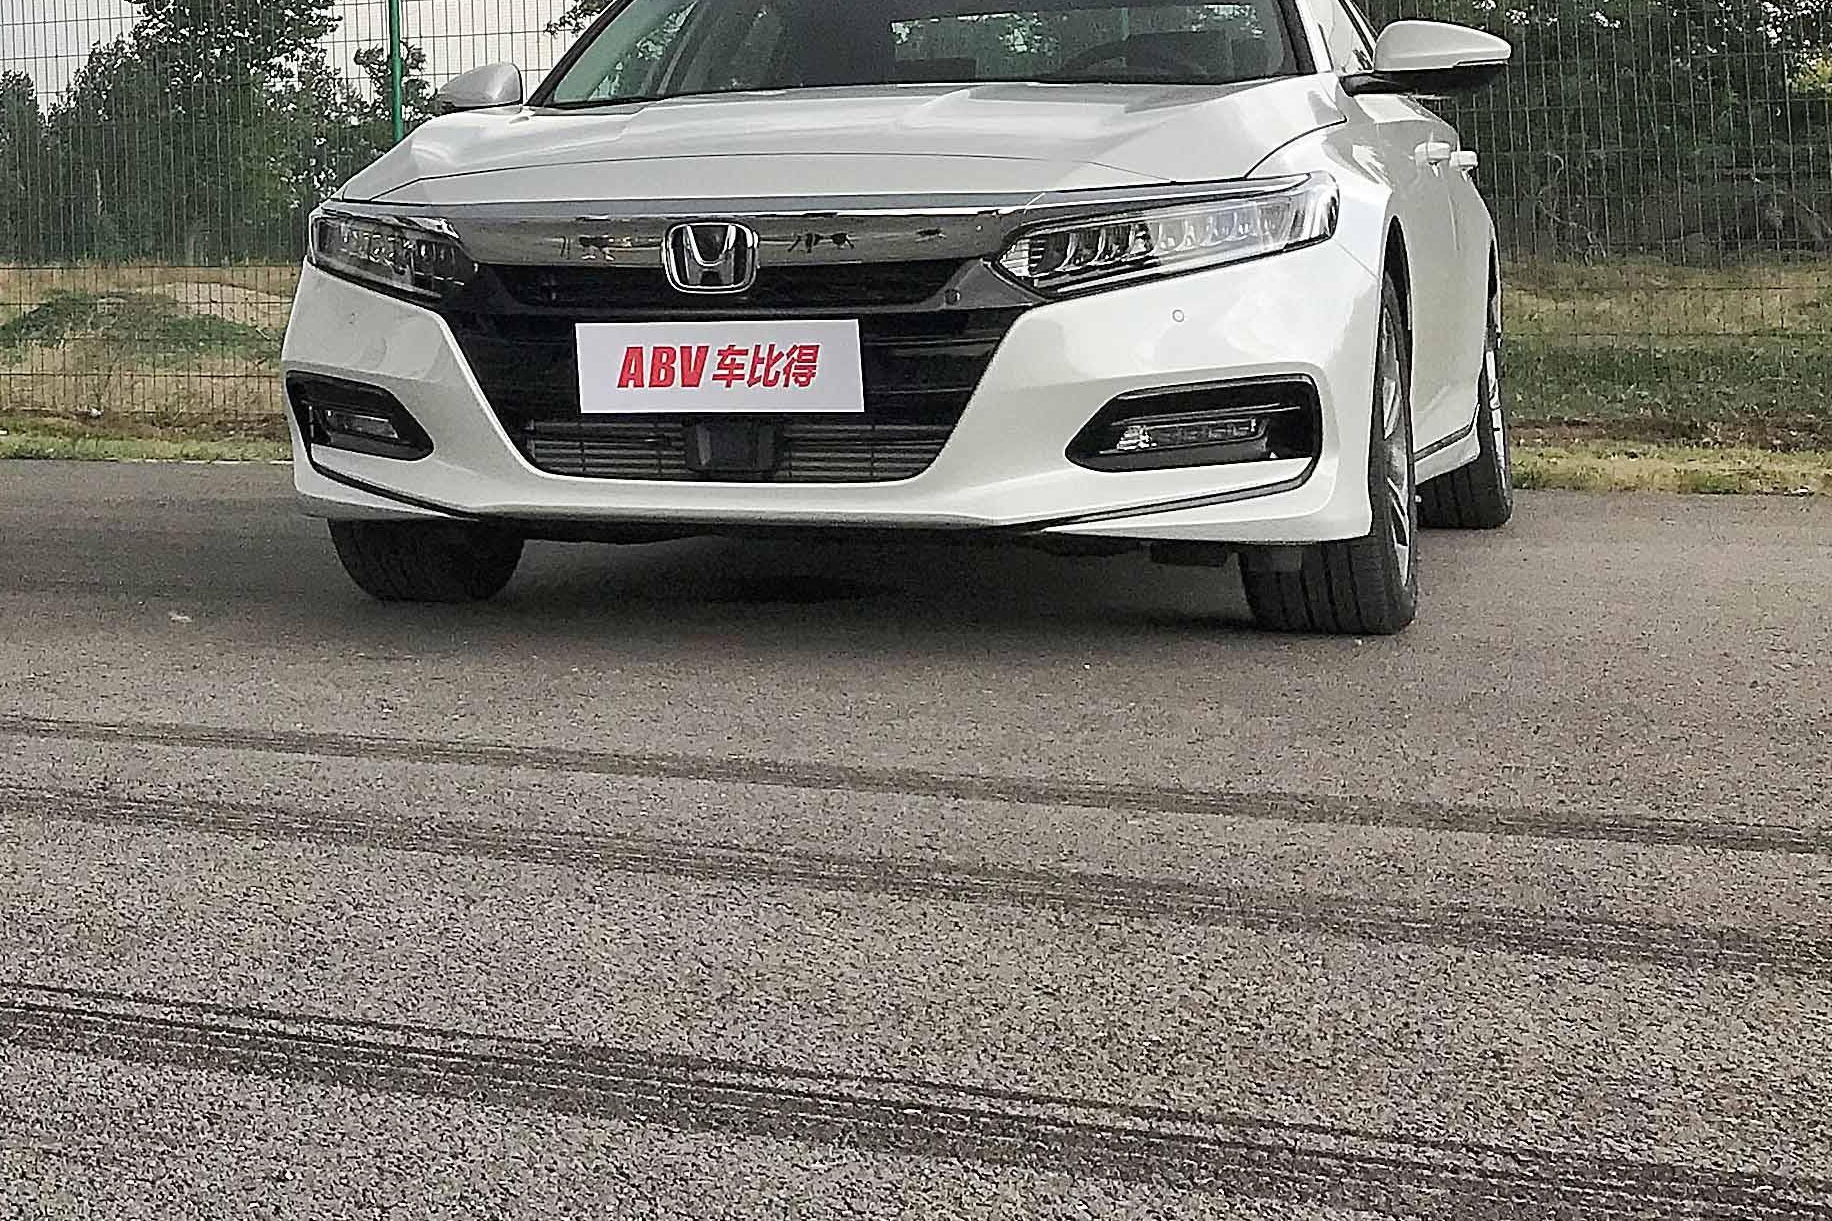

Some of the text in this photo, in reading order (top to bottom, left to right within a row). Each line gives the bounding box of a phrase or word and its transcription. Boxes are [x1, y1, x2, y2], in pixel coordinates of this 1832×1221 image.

[616, 343, 820, 388] ABV 车比得
